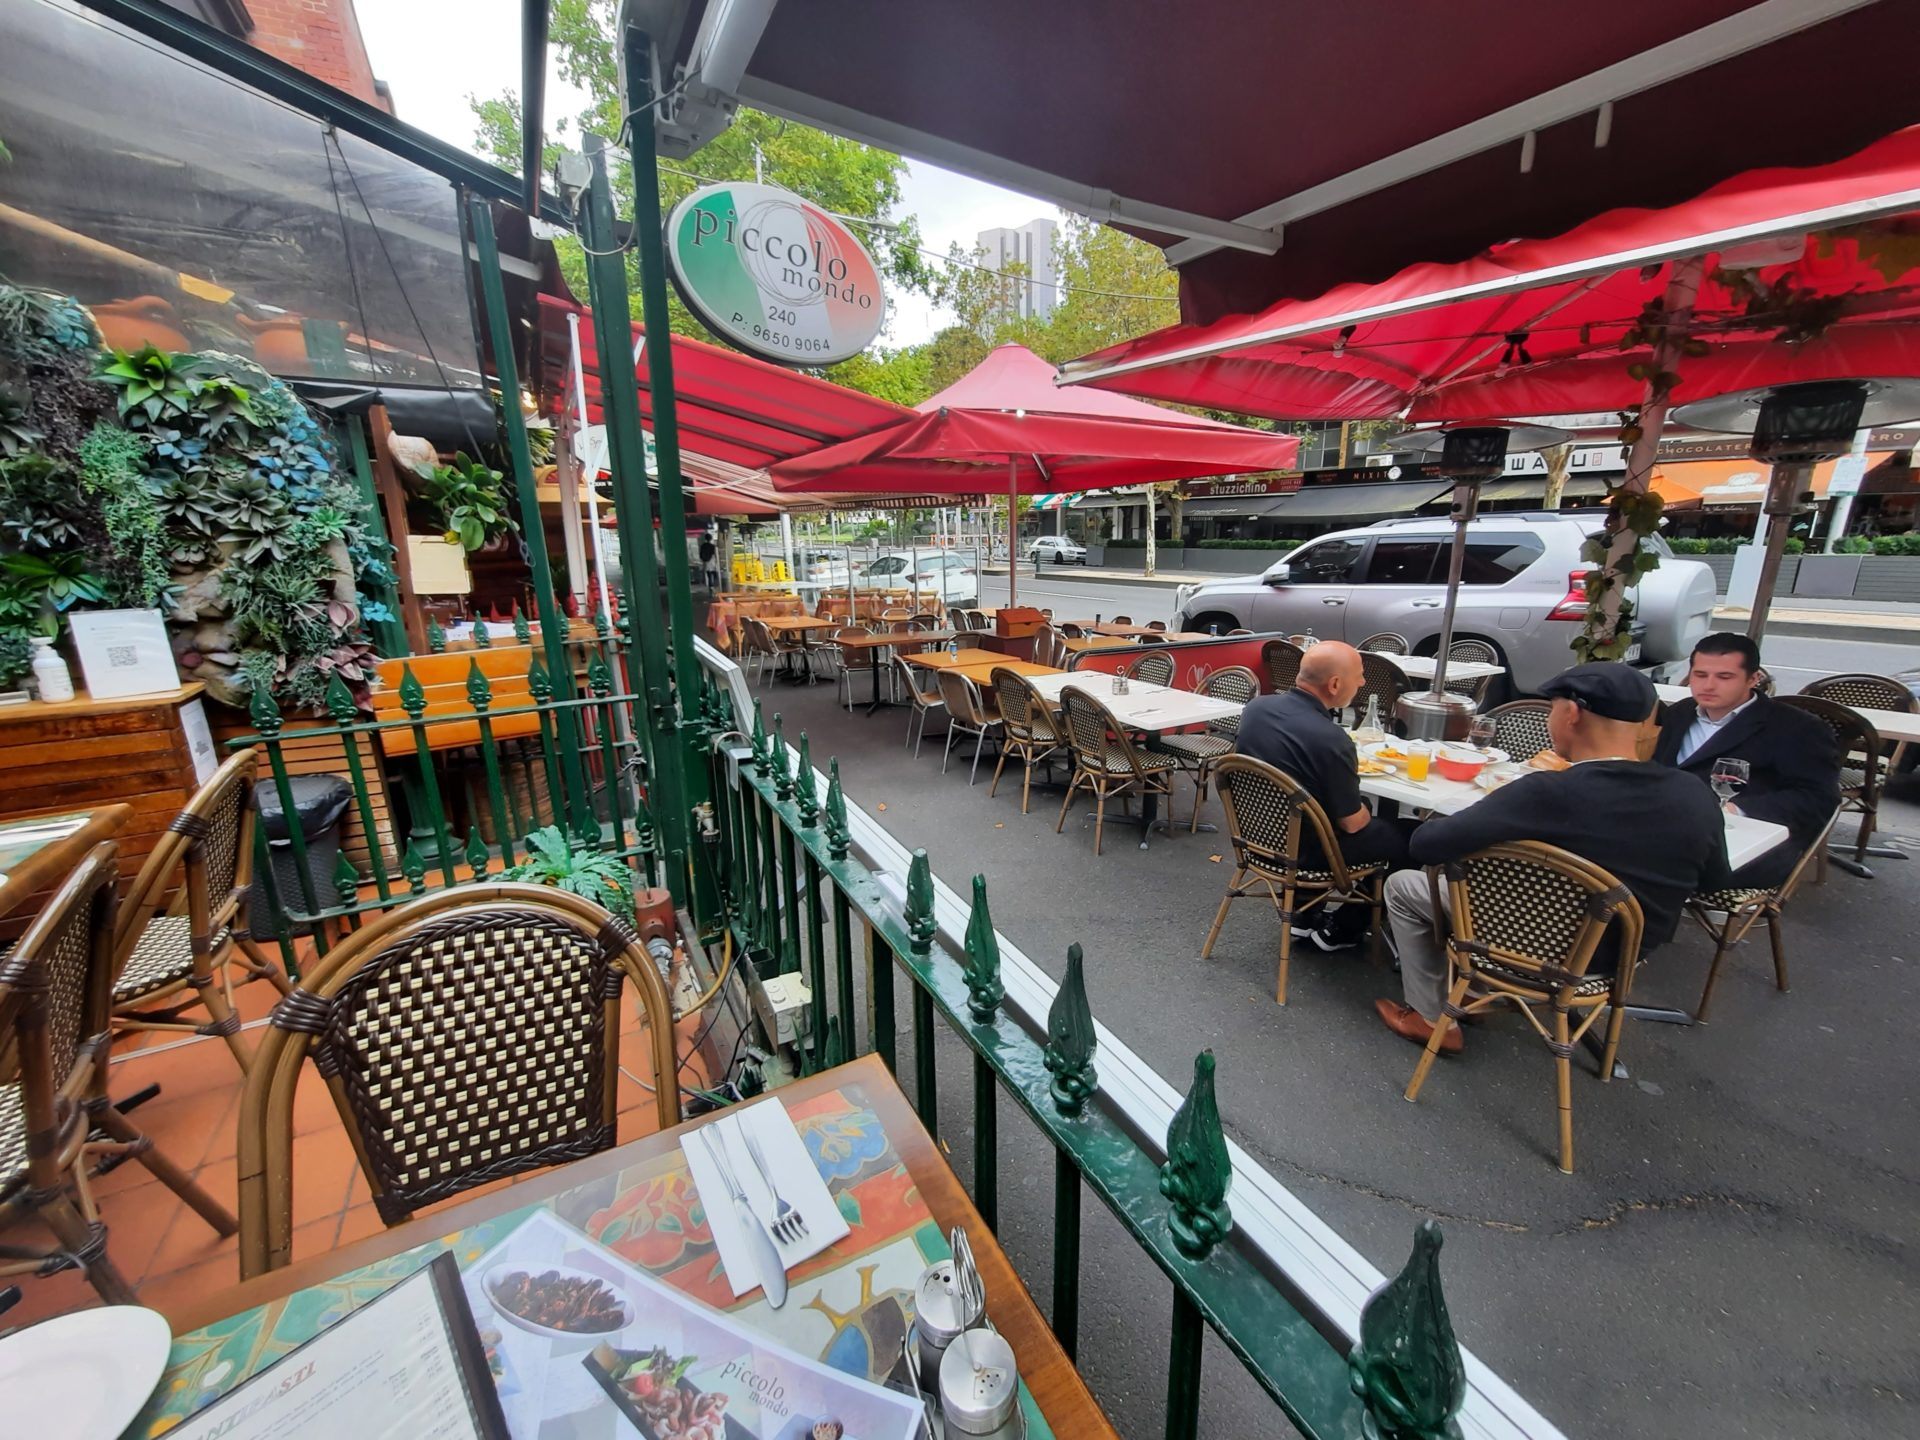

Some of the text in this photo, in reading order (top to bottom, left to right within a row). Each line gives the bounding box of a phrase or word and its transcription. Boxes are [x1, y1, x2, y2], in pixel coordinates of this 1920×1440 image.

[693, 208, 847, 281] piccolo
[782, 267, 872, 310] mondo
[768, 306, 796, 326] 240
[752, 324, 790, 348] 9650
[795, 337, 830, 352] 9064
[1656, 443, 1752, 455] CHOCOLATER
[1209, 482, 1267, 495] stuzzichino
[720, 1361, 784, 1401] piccolo
[748, 1390, 789, 1417] mondo
